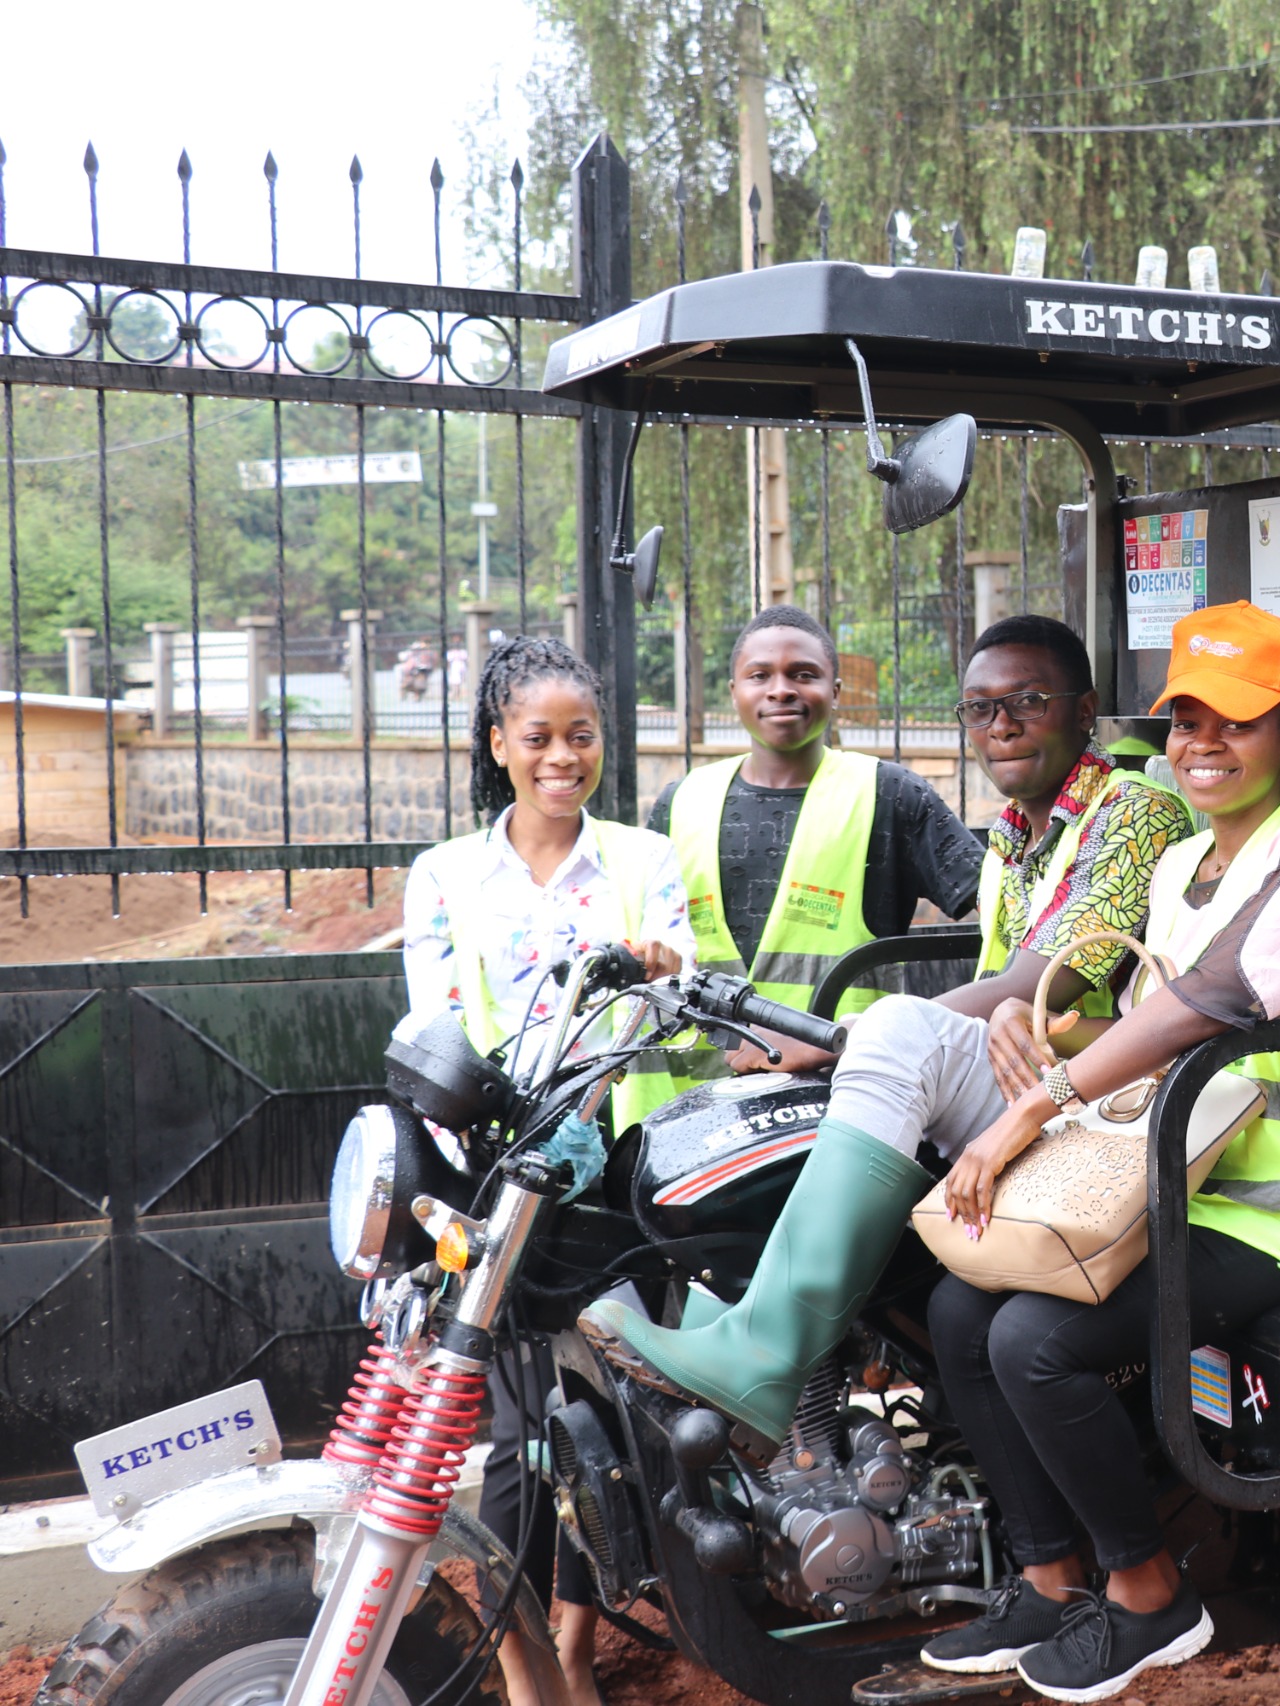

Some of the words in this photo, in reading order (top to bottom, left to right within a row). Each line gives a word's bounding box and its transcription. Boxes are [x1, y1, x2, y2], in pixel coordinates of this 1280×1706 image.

[1024, 299, 1272, 350] KETCH'S
[1141, 572, 1191, 593] DECENTAS
[803, 899, 836, 913] DECENTAS
[102, 1409, 255, 1479] KETCH'S
[870, 1480, 902, 1489] KETCH'S
[825, 1572, 873, 1585] KETCH'S
[322, 1565, 395, 1706] ETCH'S
